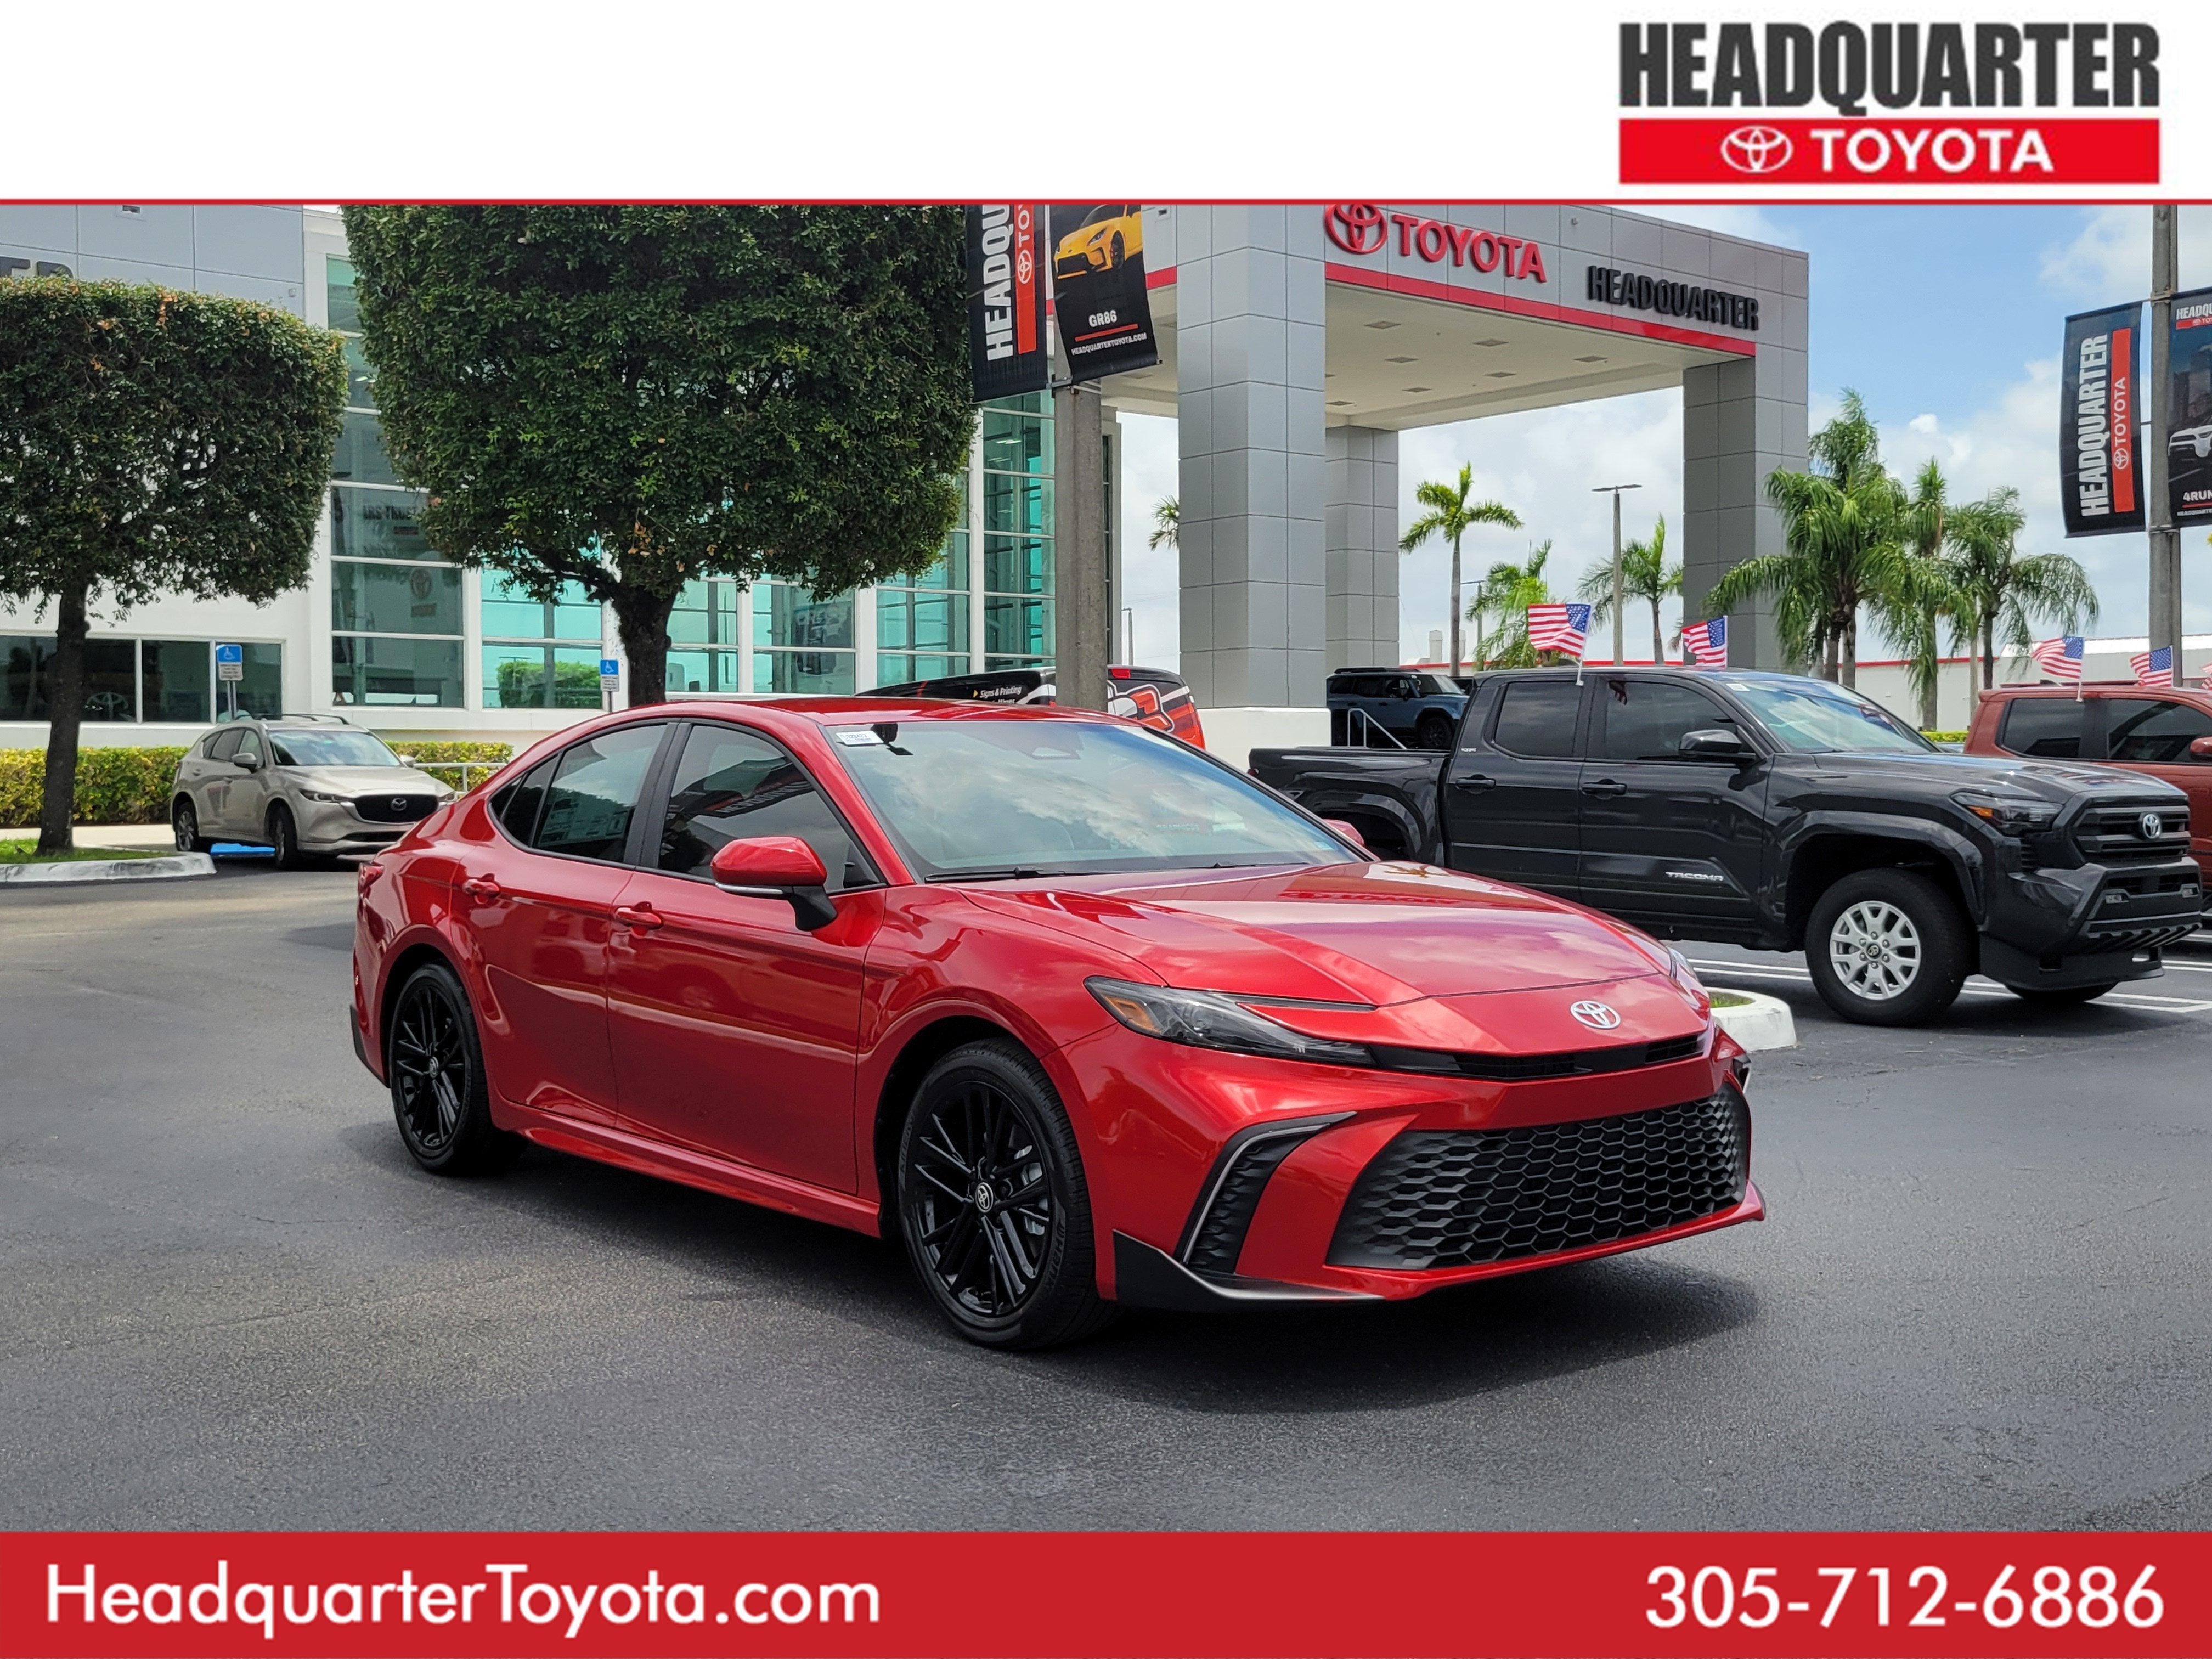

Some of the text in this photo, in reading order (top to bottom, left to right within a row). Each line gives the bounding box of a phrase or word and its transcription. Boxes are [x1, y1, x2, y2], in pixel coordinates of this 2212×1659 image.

[1392, 215, 1547, 283] TOYOTA
[1088, 309, 1118, 327] GR86
[1587, 265, 1759, 330] HEADQUARTER
[1071, 332, 1148, 356] HEADQUARTERTOYOTA.COM
[2078, 334, 2111, 517] HEADQUARTER
[2115, 376, 2126, 446] TOYOTA
[979, 690, 995, 699] Signs
[1000, 685, 1022, 696] Printing
[1665, 871, 1724, 881] TACOMA
